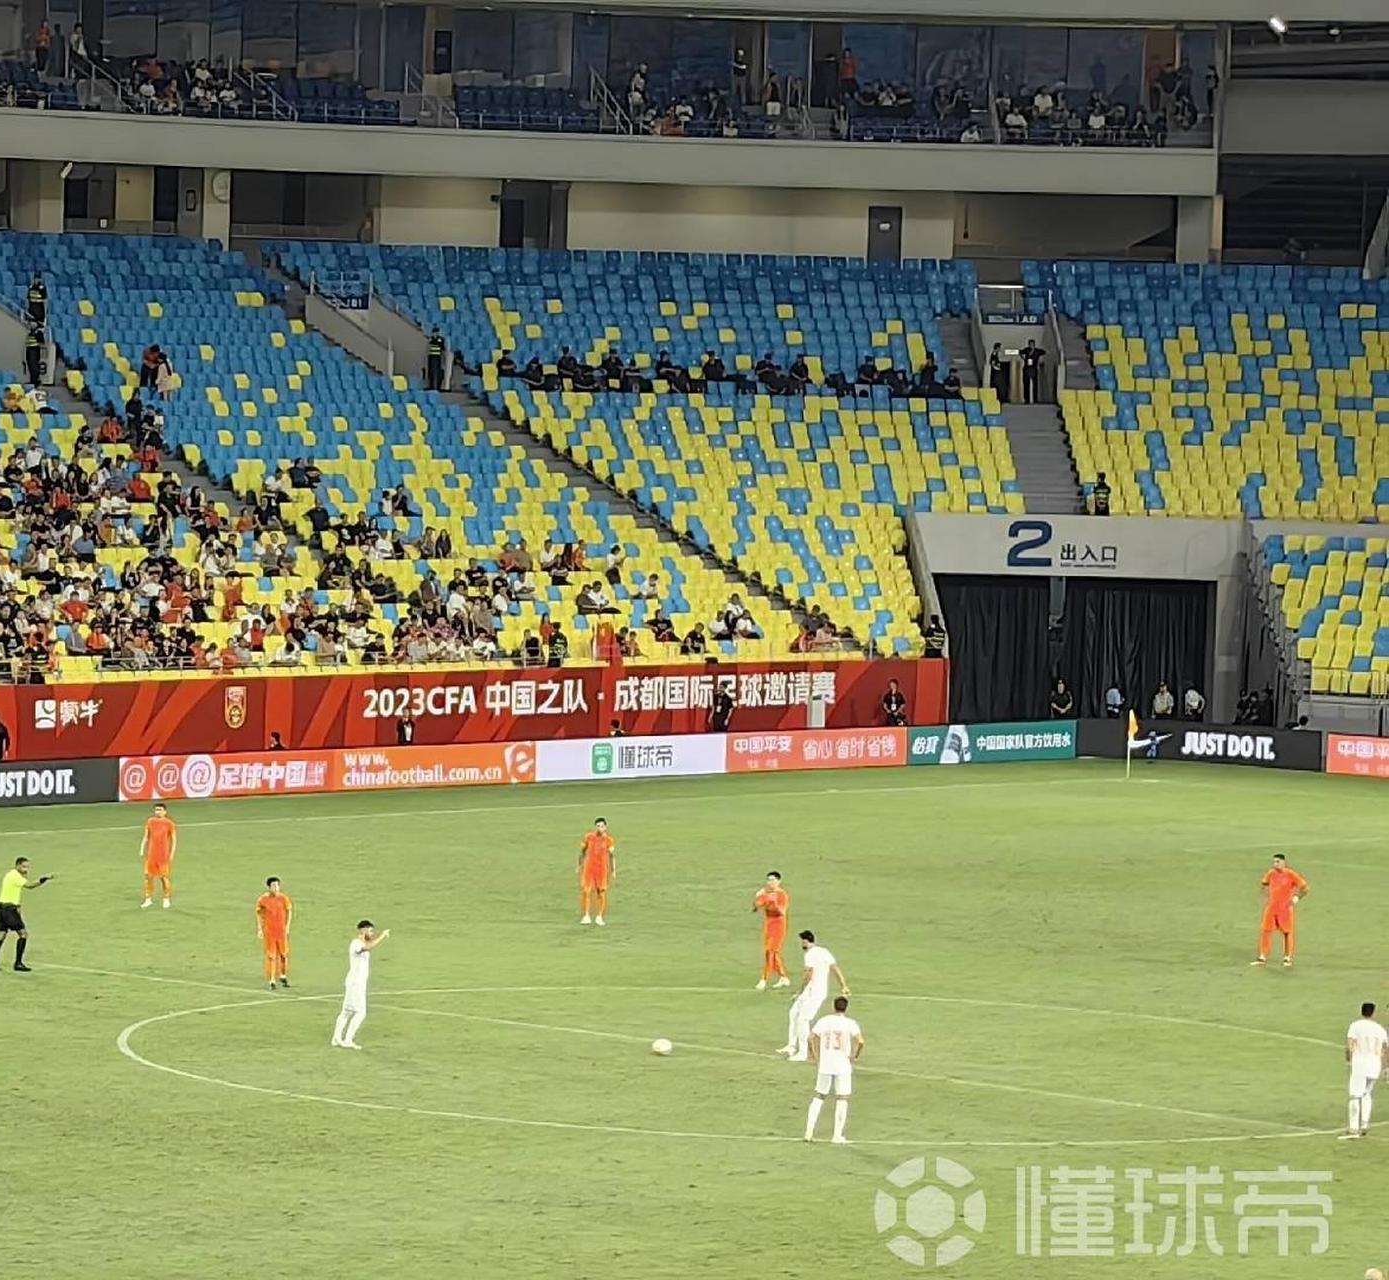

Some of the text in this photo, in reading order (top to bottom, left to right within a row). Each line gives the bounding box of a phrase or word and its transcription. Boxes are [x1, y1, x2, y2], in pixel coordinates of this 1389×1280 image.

[1007, 520, 1052, 567] 2
[1060, 543, 1118, 563] 出入口
[363, 685, 478, 719] 2023CFA
[733, 735, 794, 754] 中国平安
[976, 733, 1071, 750] 中国国家队官方饮用水
[1181, 731, 1276, 760] JUST DO IT.
[343, 752, 389, 767] www.
[618, 745, 673, 769] 懂球帝
[27, 770, 54, 795] DO
[56, 768, 75, 794] IT.
[342, 765, 503, 786] chinafootball.com.cn
